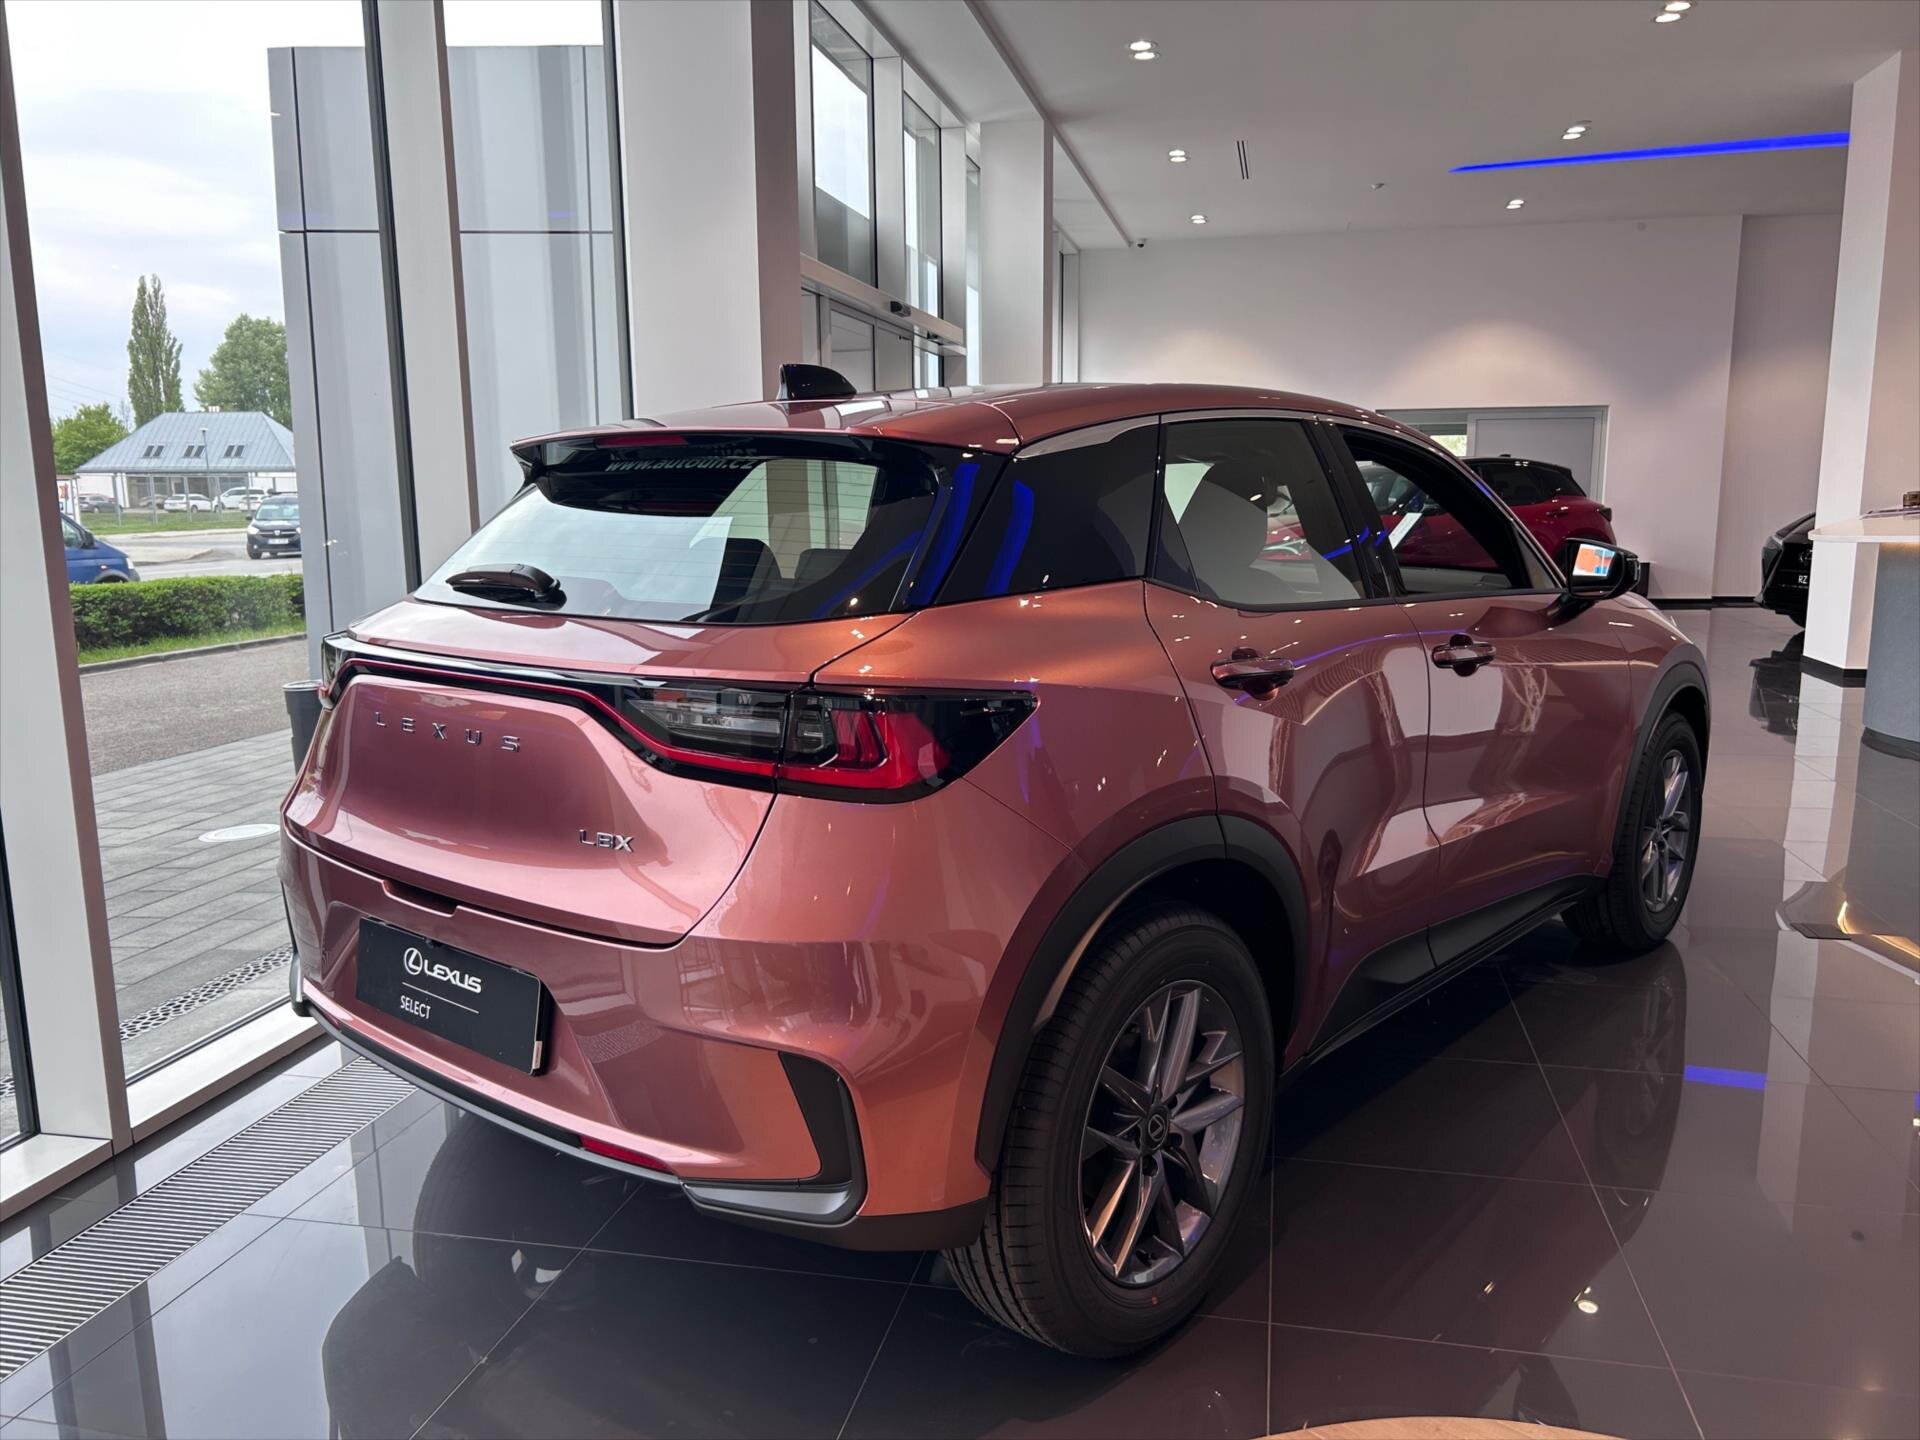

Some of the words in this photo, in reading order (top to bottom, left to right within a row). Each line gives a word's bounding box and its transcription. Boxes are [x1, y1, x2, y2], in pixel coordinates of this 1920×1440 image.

[1798, 575, 1808, 584] RZ
[375, 711, 521, 752] LEXUS
[579, 829, 634, 853] LBX
[424, 959, 482, 994] LEXUS
[400, 995, 431, 1020] SELECT
